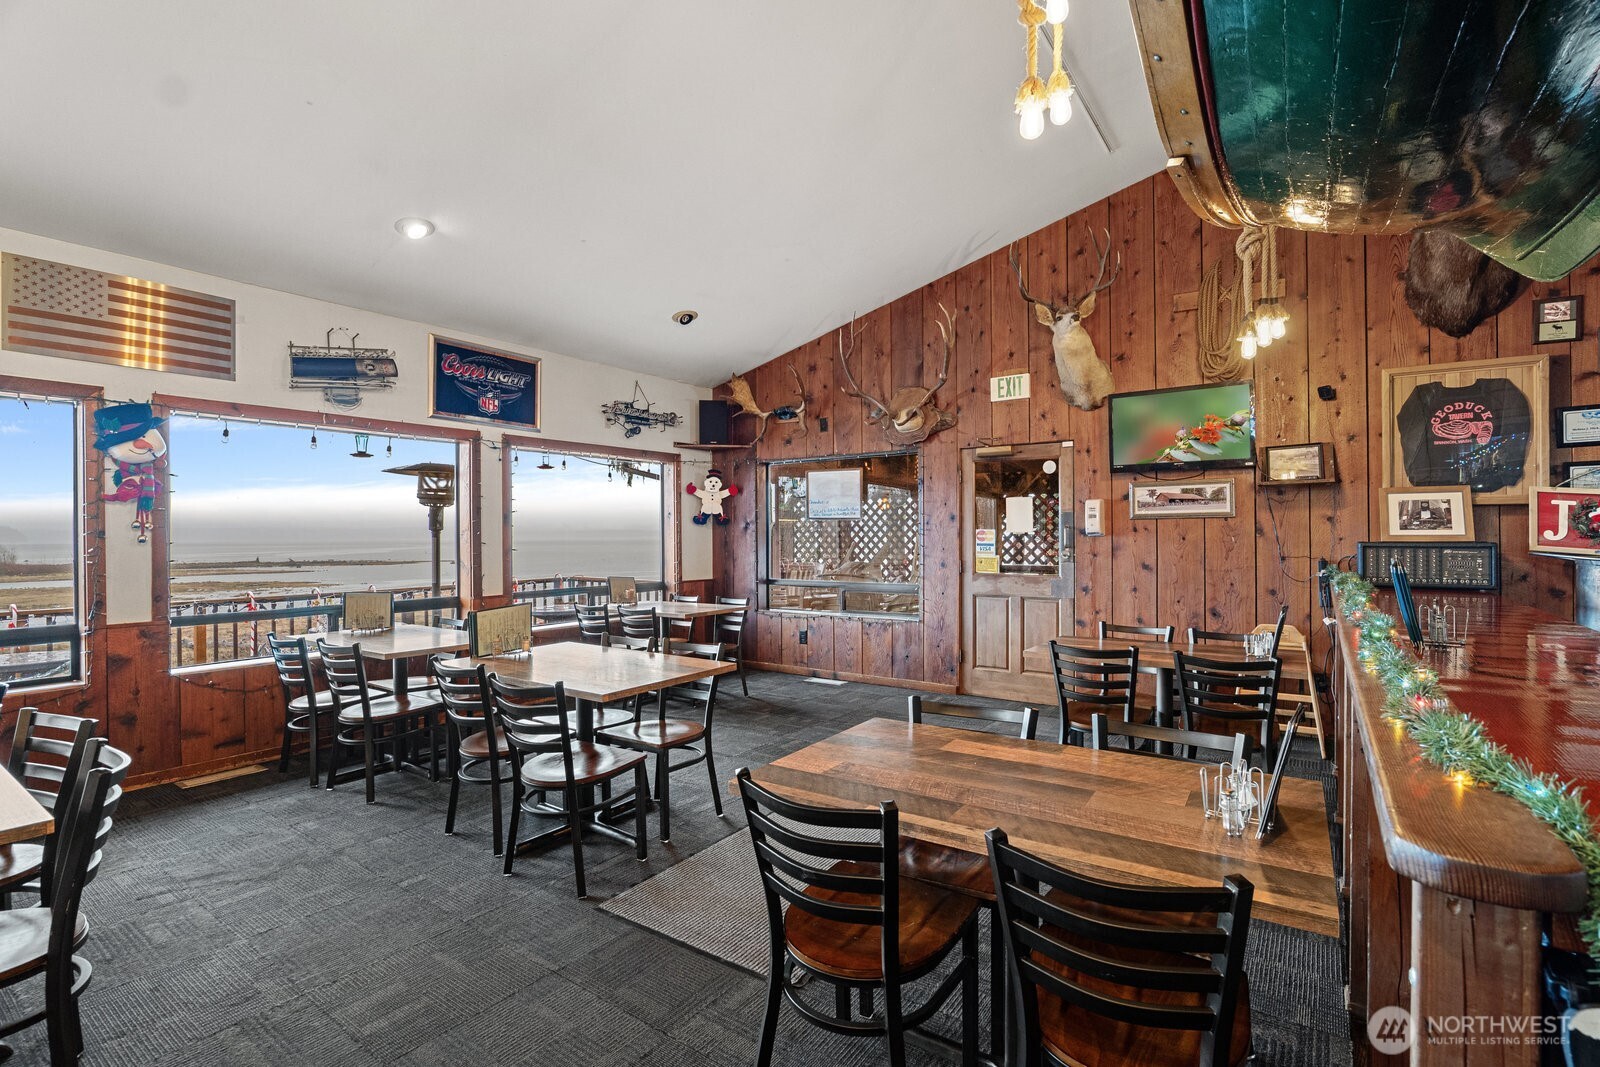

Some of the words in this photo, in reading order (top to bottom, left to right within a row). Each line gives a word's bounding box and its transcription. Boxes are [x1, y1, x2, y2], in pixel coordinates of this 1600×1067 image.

[441, 353, 486, 380] Coors
[486, 368, 530, 388] LIGHT
[997, 375, 1024, 399] EXIT
[480, 397, 499, 411] NFL
[1431, 401, 1493, 425] GEODUCK
[1447, 412, 1474, 421] TAVERN
